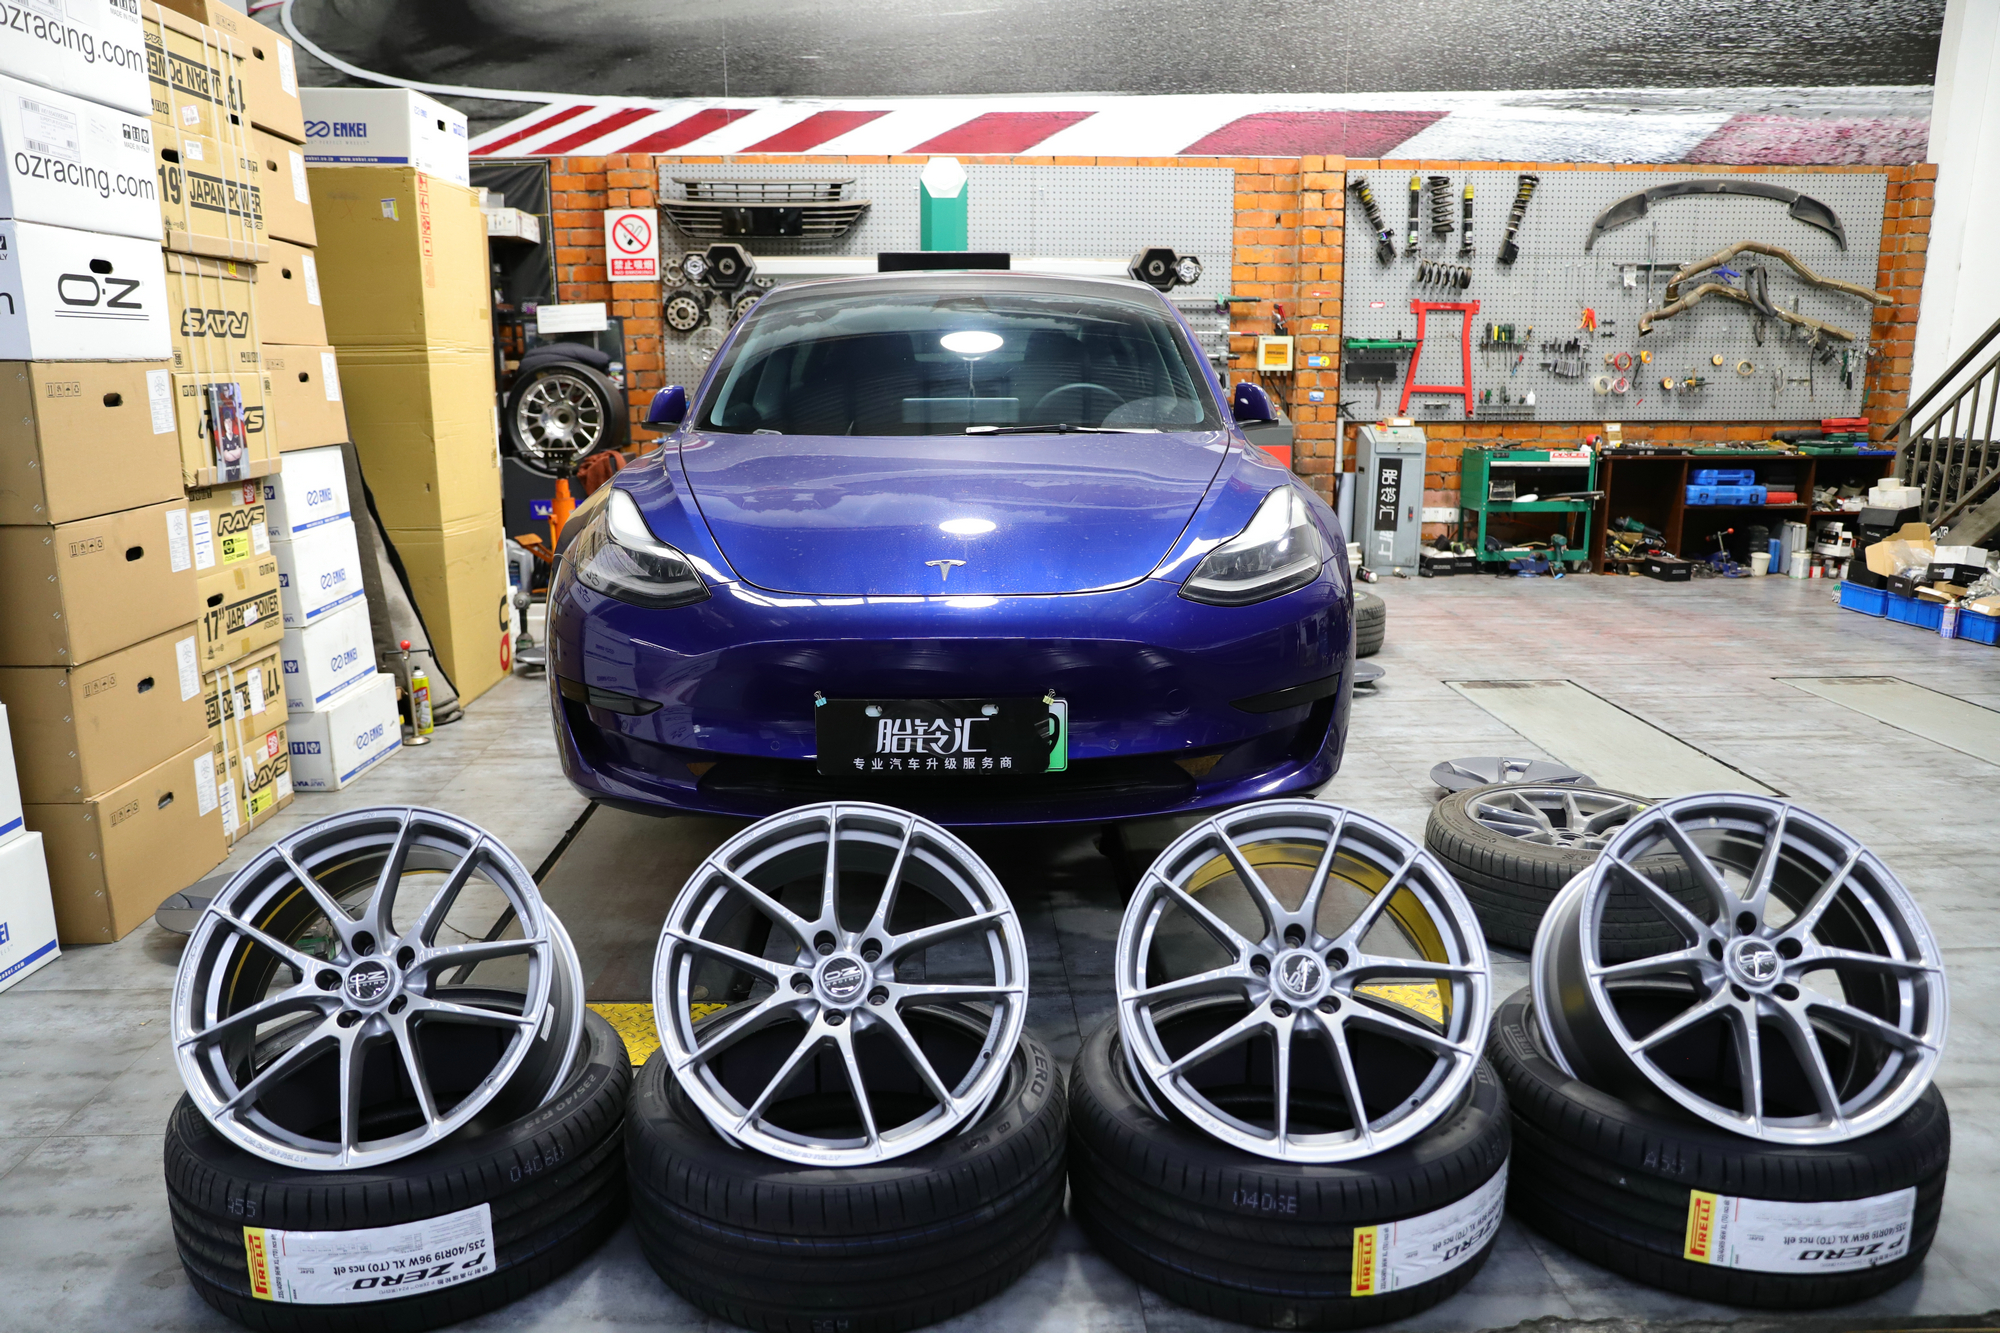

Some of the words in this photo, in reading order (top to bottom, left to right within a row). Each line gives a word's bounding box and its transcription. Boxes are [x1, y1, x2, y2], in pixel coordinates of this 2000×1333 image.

[333, 122, 367, 138] ENKEI
[14, 152, 154, 200] ozracing.com
[614, 260, 654, 270] 禁止吸烟
[181, 308, 248, 338] RAYS
[217, 505, 265, 536] RAYS
[853, 756, 1012, 770] 专业汽车升级服务商
[1029, 1044, 1048, 1098] ZERO
[1690, 1198, 1711, 1256] PIRELLI
[1784, 1237, 1795, 1245] elt
[1839, 1235, 1849, 1243] XL
[1852, 1232, 1869, 1242] 96W
[1888, 1234, 1905, 1250] P
[435, 1238, 486, 1261] 235/40R19
[1797, 1242, 1884, 1260] ZERO
[248, 1234, 268, 1294] PIRELLI
[368, 1262, 389, 1273] (TO)
[393, 1259, 405, 1269] XL
[409, 1253, 432, 1267] 96W
[462, 1252, 486, 1269] P
[1356, 1234, 1372, 1291] PIRELLI
[333, 1267, 346, 1276] elt
[352, 1262, 454, 1290] ZERO
